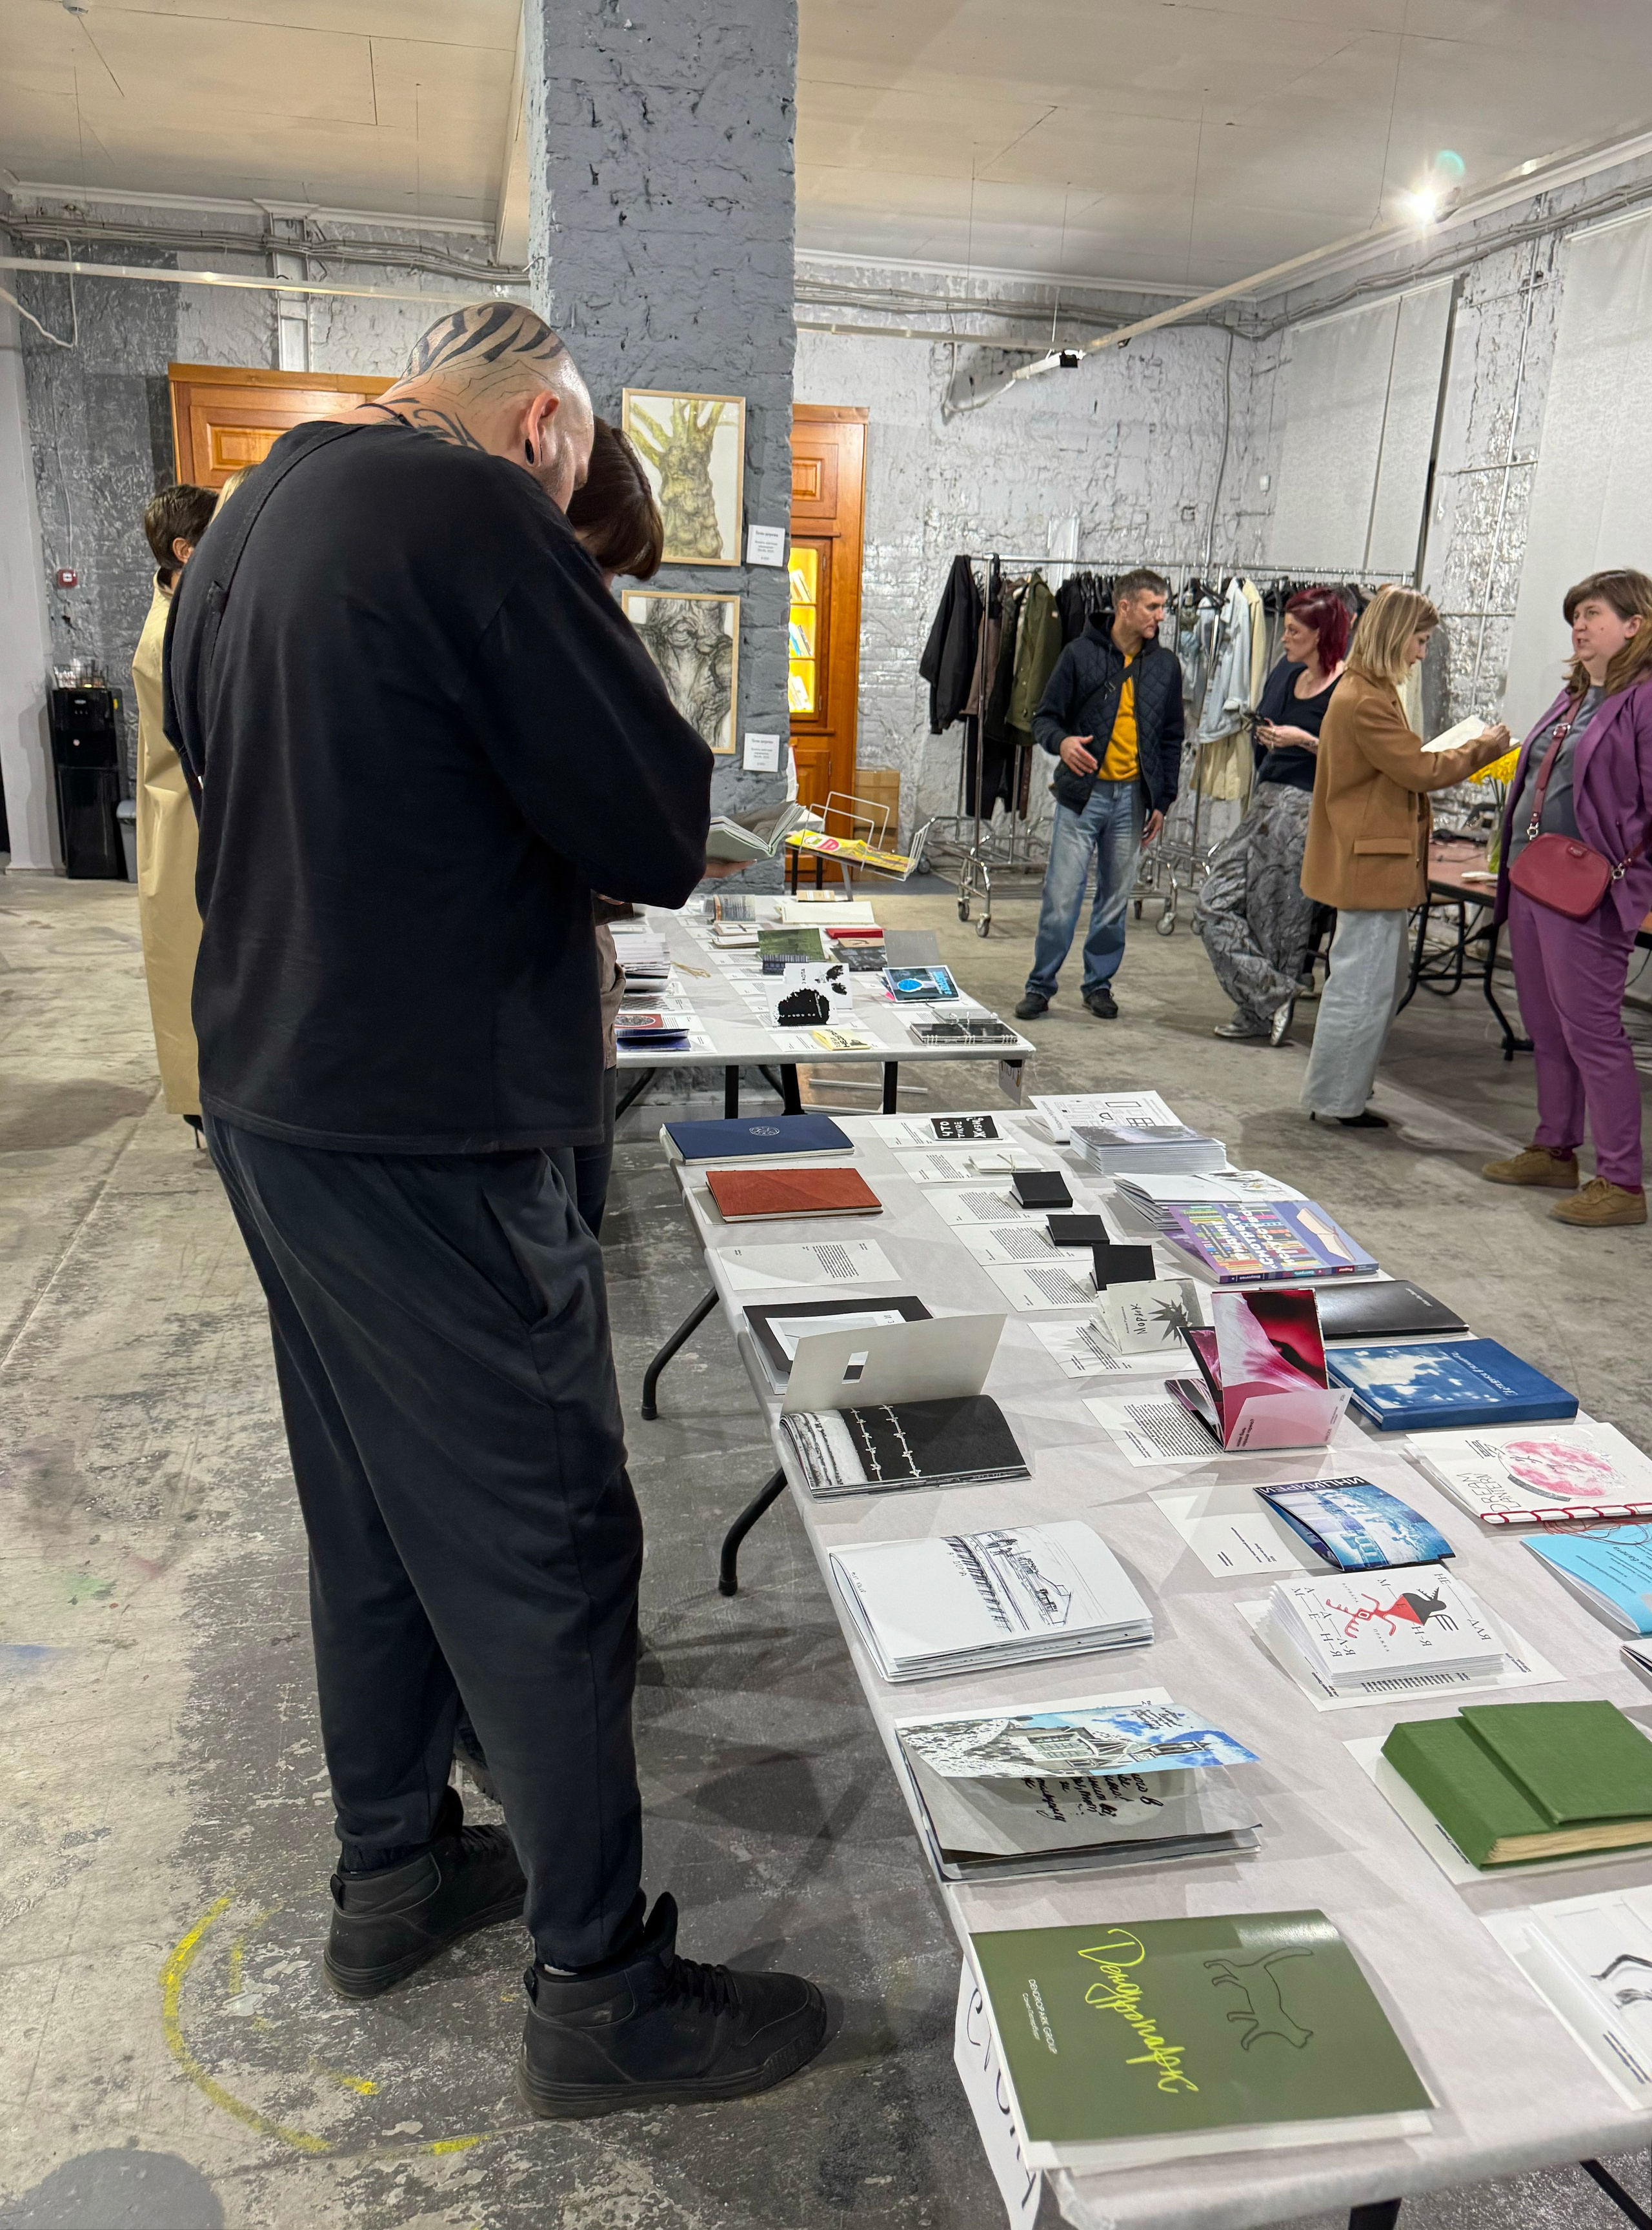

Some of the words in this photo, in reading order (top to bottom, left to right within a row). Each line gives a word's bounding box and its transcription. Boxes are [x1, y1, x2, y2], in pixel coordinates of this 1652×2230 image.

[938, 1121, 949, 1137] ЧТО
[1456, 1473, 1510, 1512] DREAM
[1474, 1473, 1522, 1508] LANTERN
[1433, 1572, 1451, 1585] НЕ
[1467, 1618, 1492, 1642] ДЛЯ
[1028, 1978, 1049, 2025] DENDROPARK
[1043, 2025, 1058, 2054] GROUP
